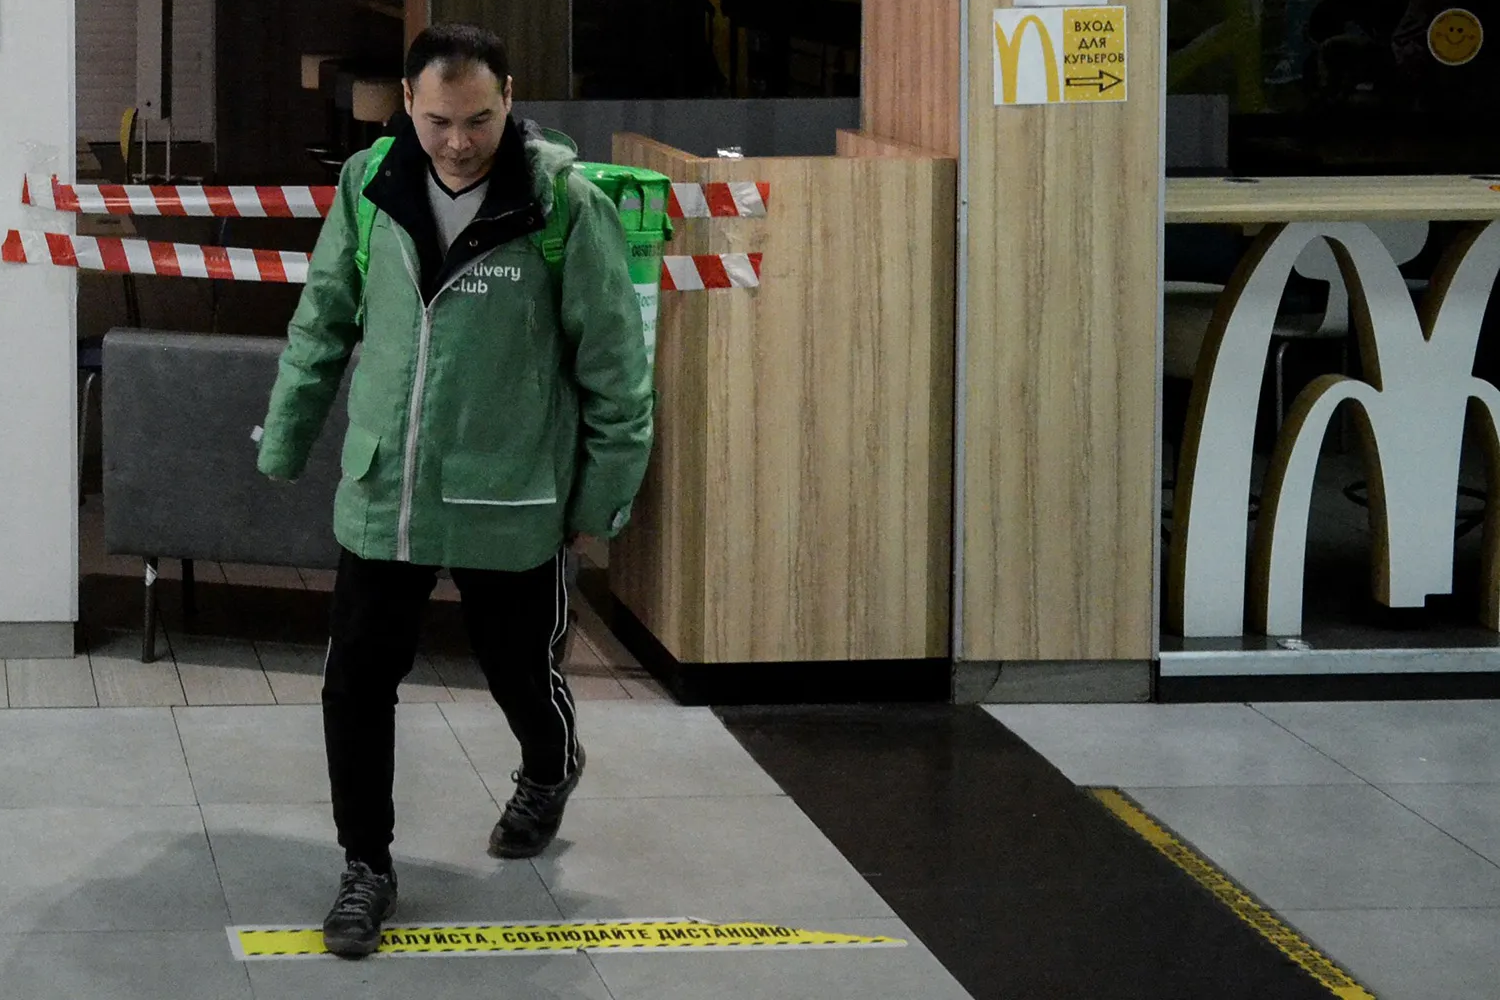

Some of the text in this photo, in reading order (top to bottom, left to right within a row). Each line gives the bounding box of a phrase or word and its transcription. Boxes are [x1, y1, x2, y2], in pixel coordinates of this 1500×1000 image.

[1074, 20, 1115, 33] ВХОД
[1077, 37, 1107, 51] ДЛЯ
[1063, 52, 1125, 64] КУРЬЕРОВ
[465, 262, 521, 282] elivery
[501, 927, 652, 944] СОБЛЮДАЙТЕ
